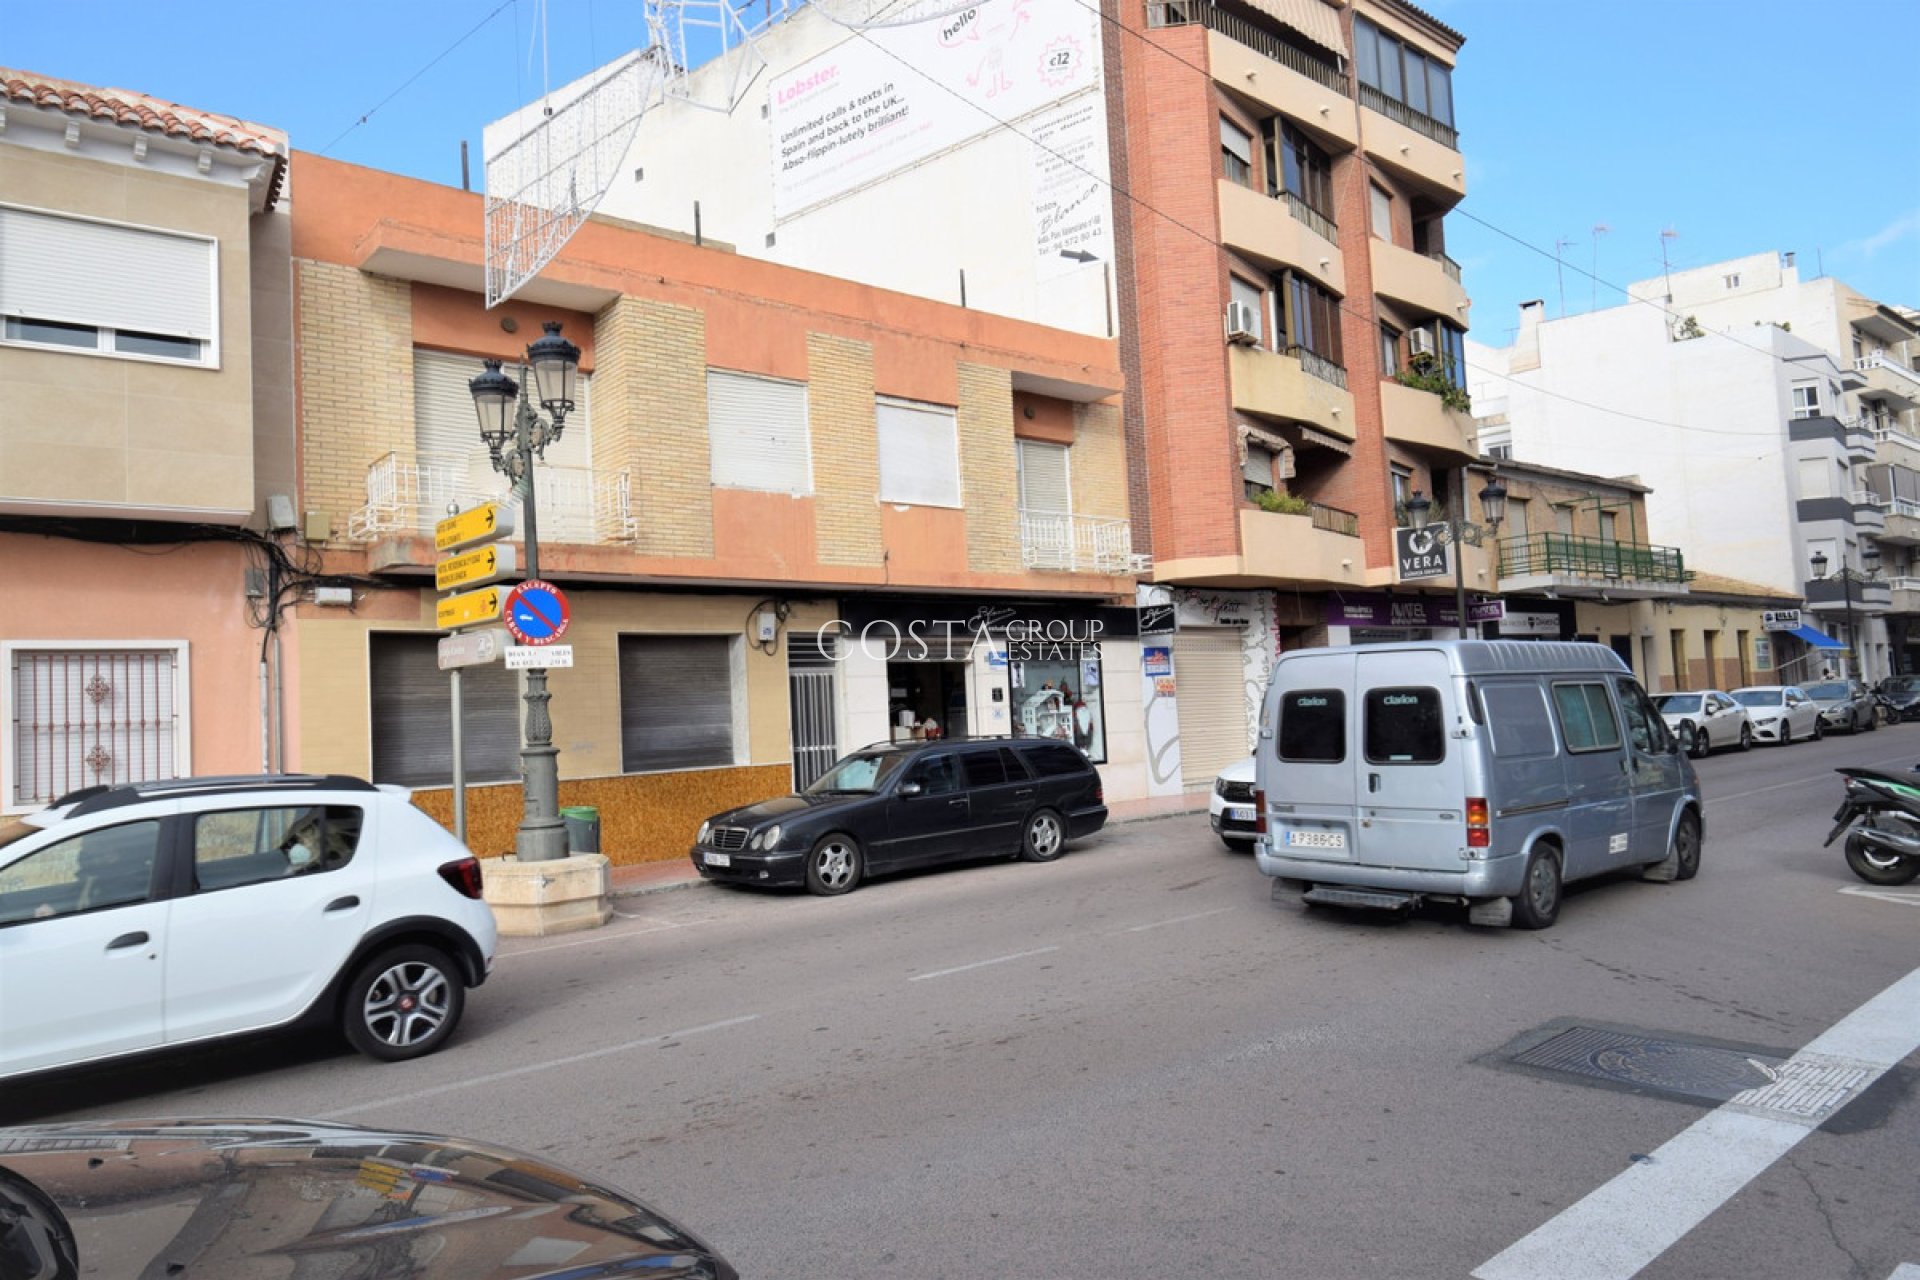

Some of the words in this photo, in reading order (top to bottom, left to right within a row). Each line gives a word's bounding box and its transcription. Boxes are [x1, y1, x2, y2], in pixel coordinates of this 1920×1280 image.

[942, 8, 978, 41] hello
[781, 114, 824, 144] Unlimited
[825, 106, 847, 122] calls
[849, 100, 856, 111] &
[857, 89, 883, 106] texts
[884, 82, 894, 94] in
[867, 105, 910, 133] brilliant!
[781, 141, 806, 158] Spain
[807, 129, 825, 146] and
[827, 119, 849, 137] back
[852, 113, 862, 124] to
[864, 104, 881, 119] the
[1402, 554, 1443, 570] VERA
[516, 580, 558, 595] EXCEPTO
[1383, 693, 1419, 706] clarion
